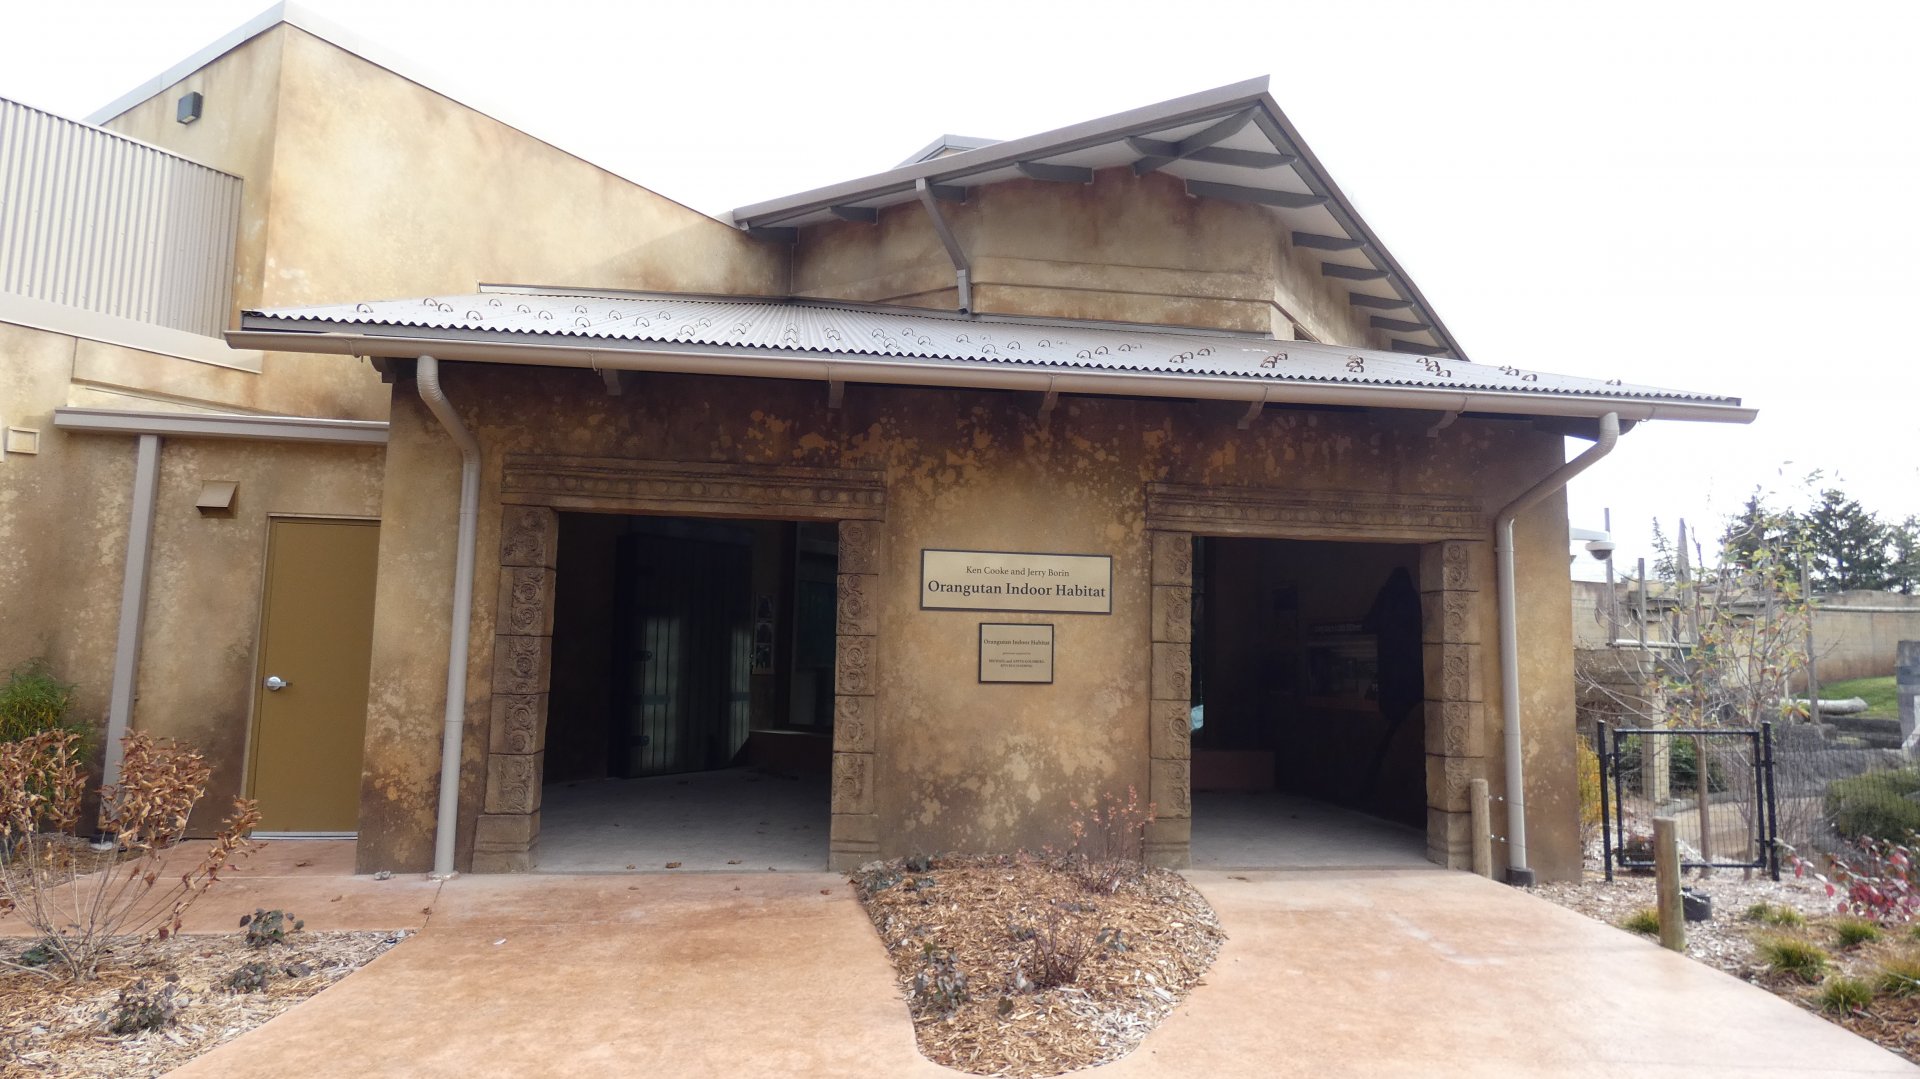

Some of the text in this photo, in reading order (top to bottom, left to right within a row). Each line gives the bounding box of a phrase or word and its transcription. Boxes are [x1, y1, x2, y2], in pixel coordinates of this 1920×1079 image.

[966, 566, 1070, 577] Ken Cooke and Jerry Borin
[928, 580, 1106, 597] Orangutan Indoor Habitat
